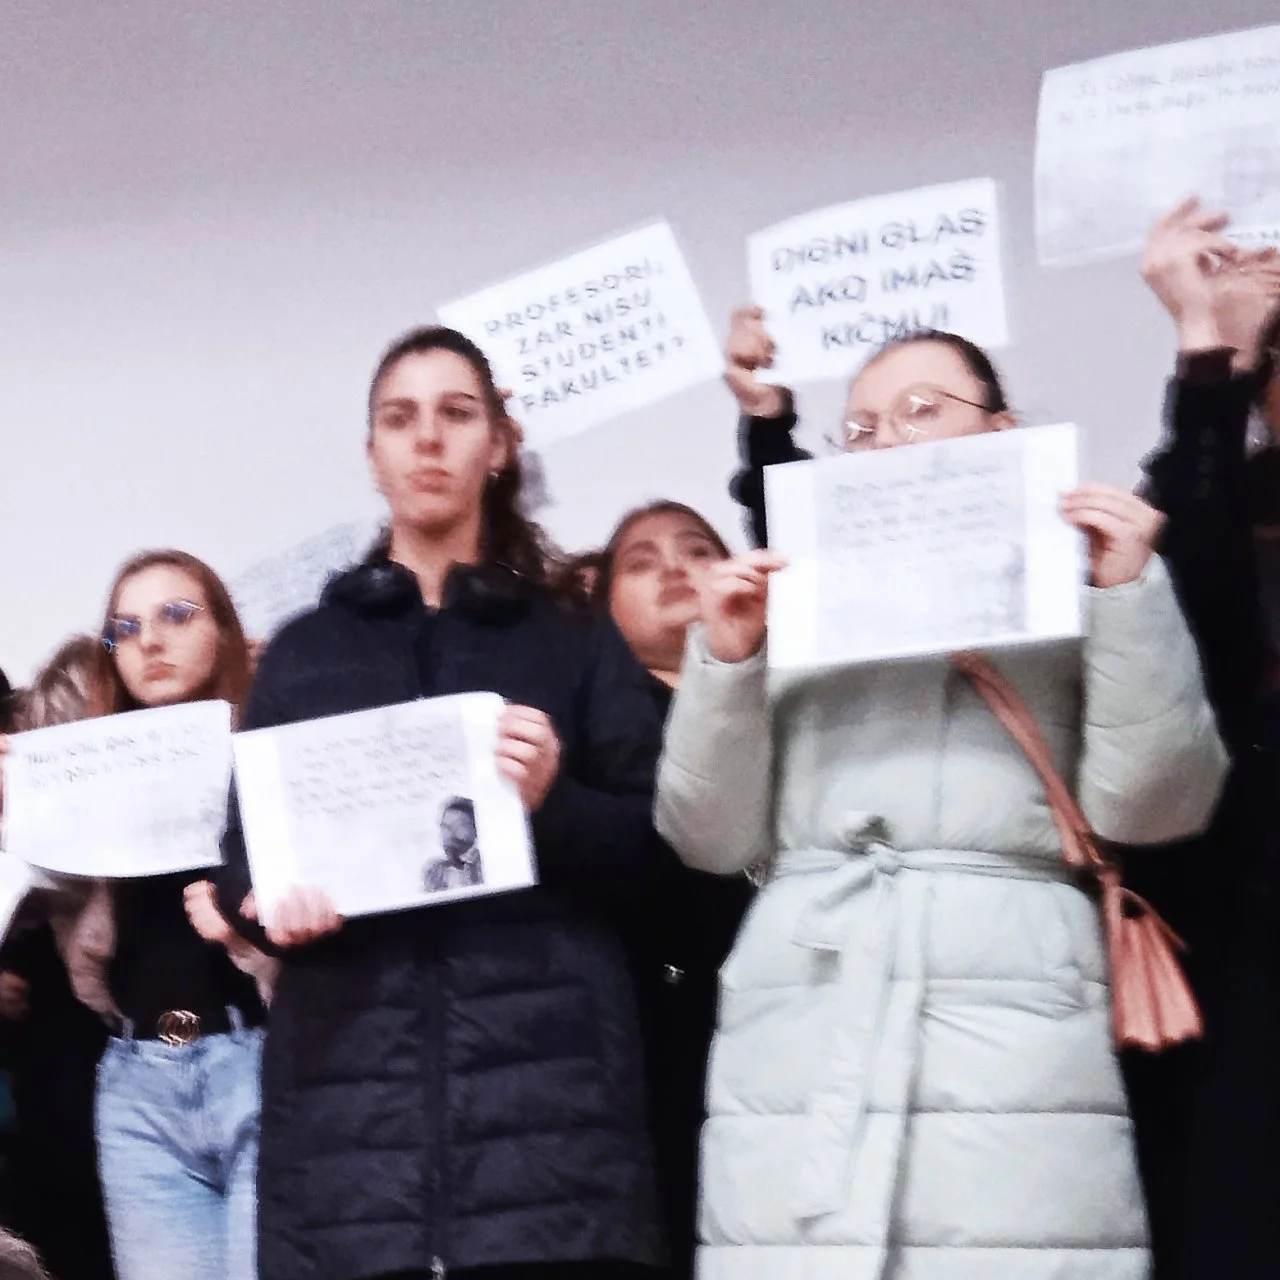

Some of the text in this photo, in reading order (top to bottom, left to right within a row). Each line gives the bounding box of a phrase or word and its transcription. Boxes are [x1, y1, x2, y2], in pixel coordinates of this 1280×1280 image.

[879, 208, 986, 249] GLAS
[516, 286, 652, 354] ZAR NISU
[790, 274, 868, 314] AKO
[521, 310, 666, 383] STUDENTI
